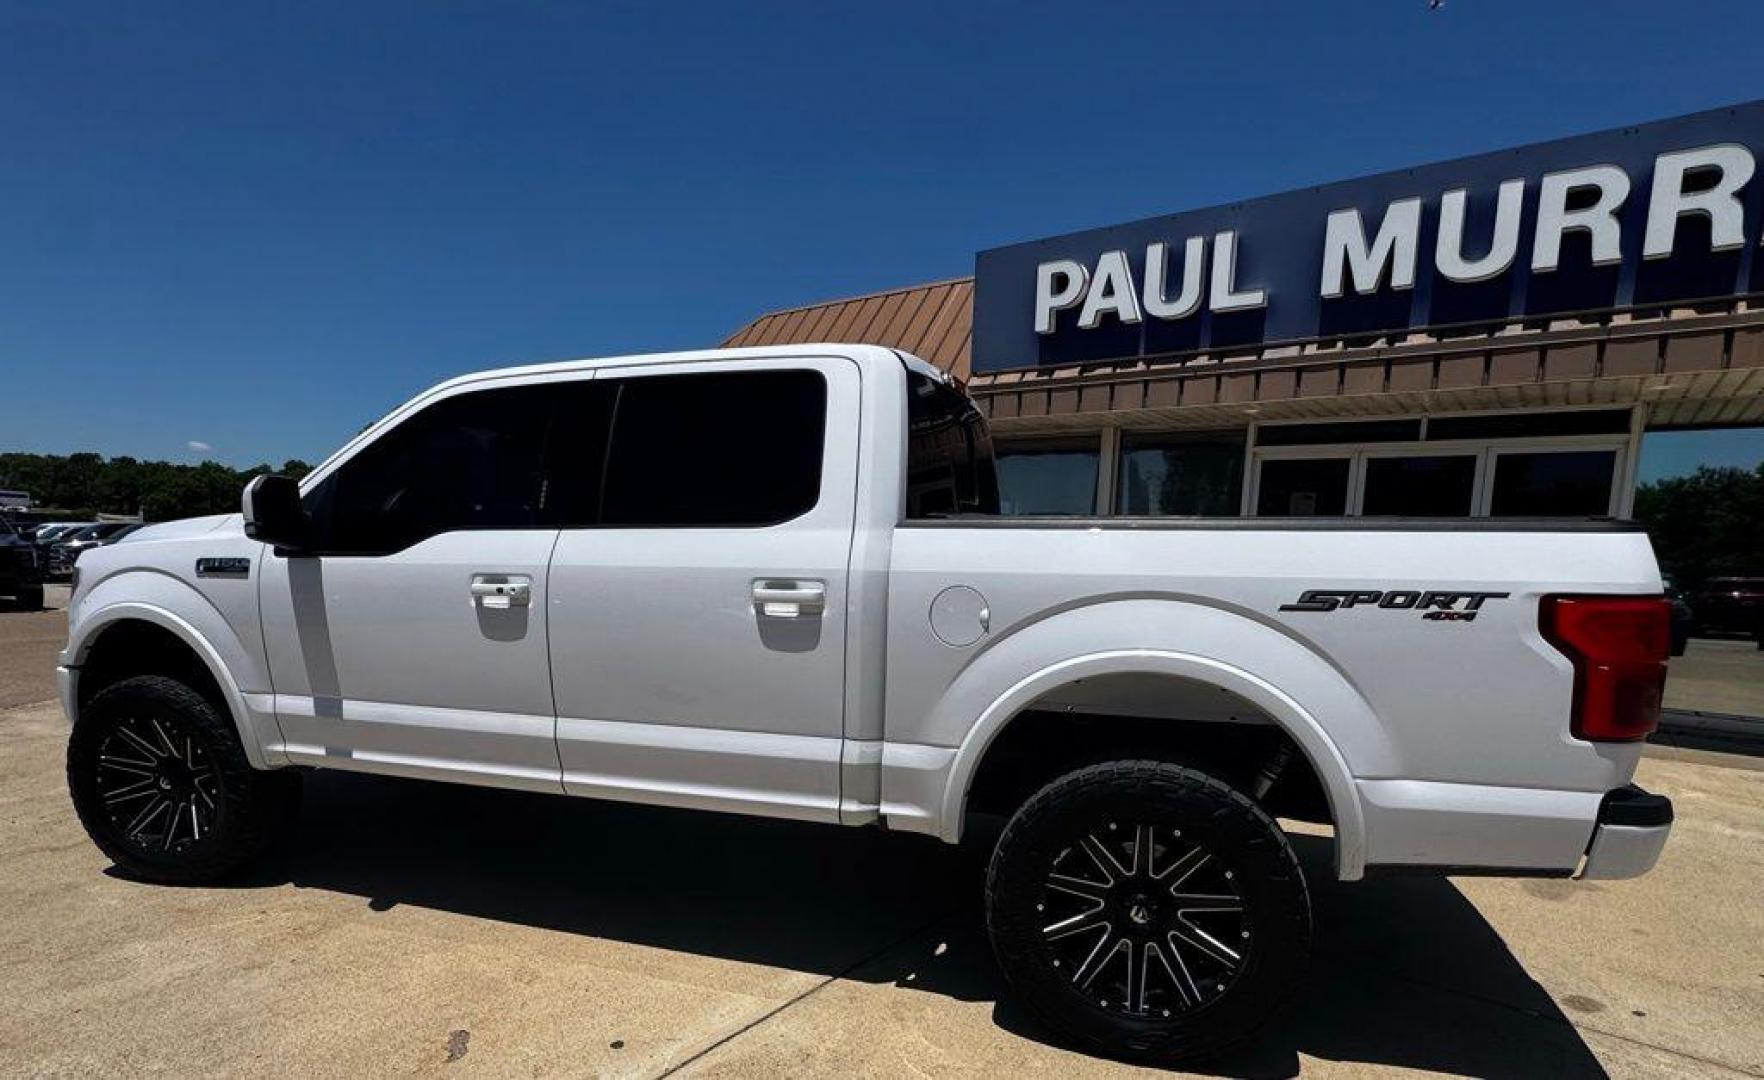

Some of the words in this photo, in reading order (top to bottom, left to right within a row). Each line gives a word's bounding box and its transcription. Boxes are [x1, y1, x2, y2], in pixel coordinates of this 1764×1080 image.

[1034, 230, 1268, 334] PAUL
[1320, 142, 1764, 299] MURR
[1278, 590, 1511, 612] SPORT
